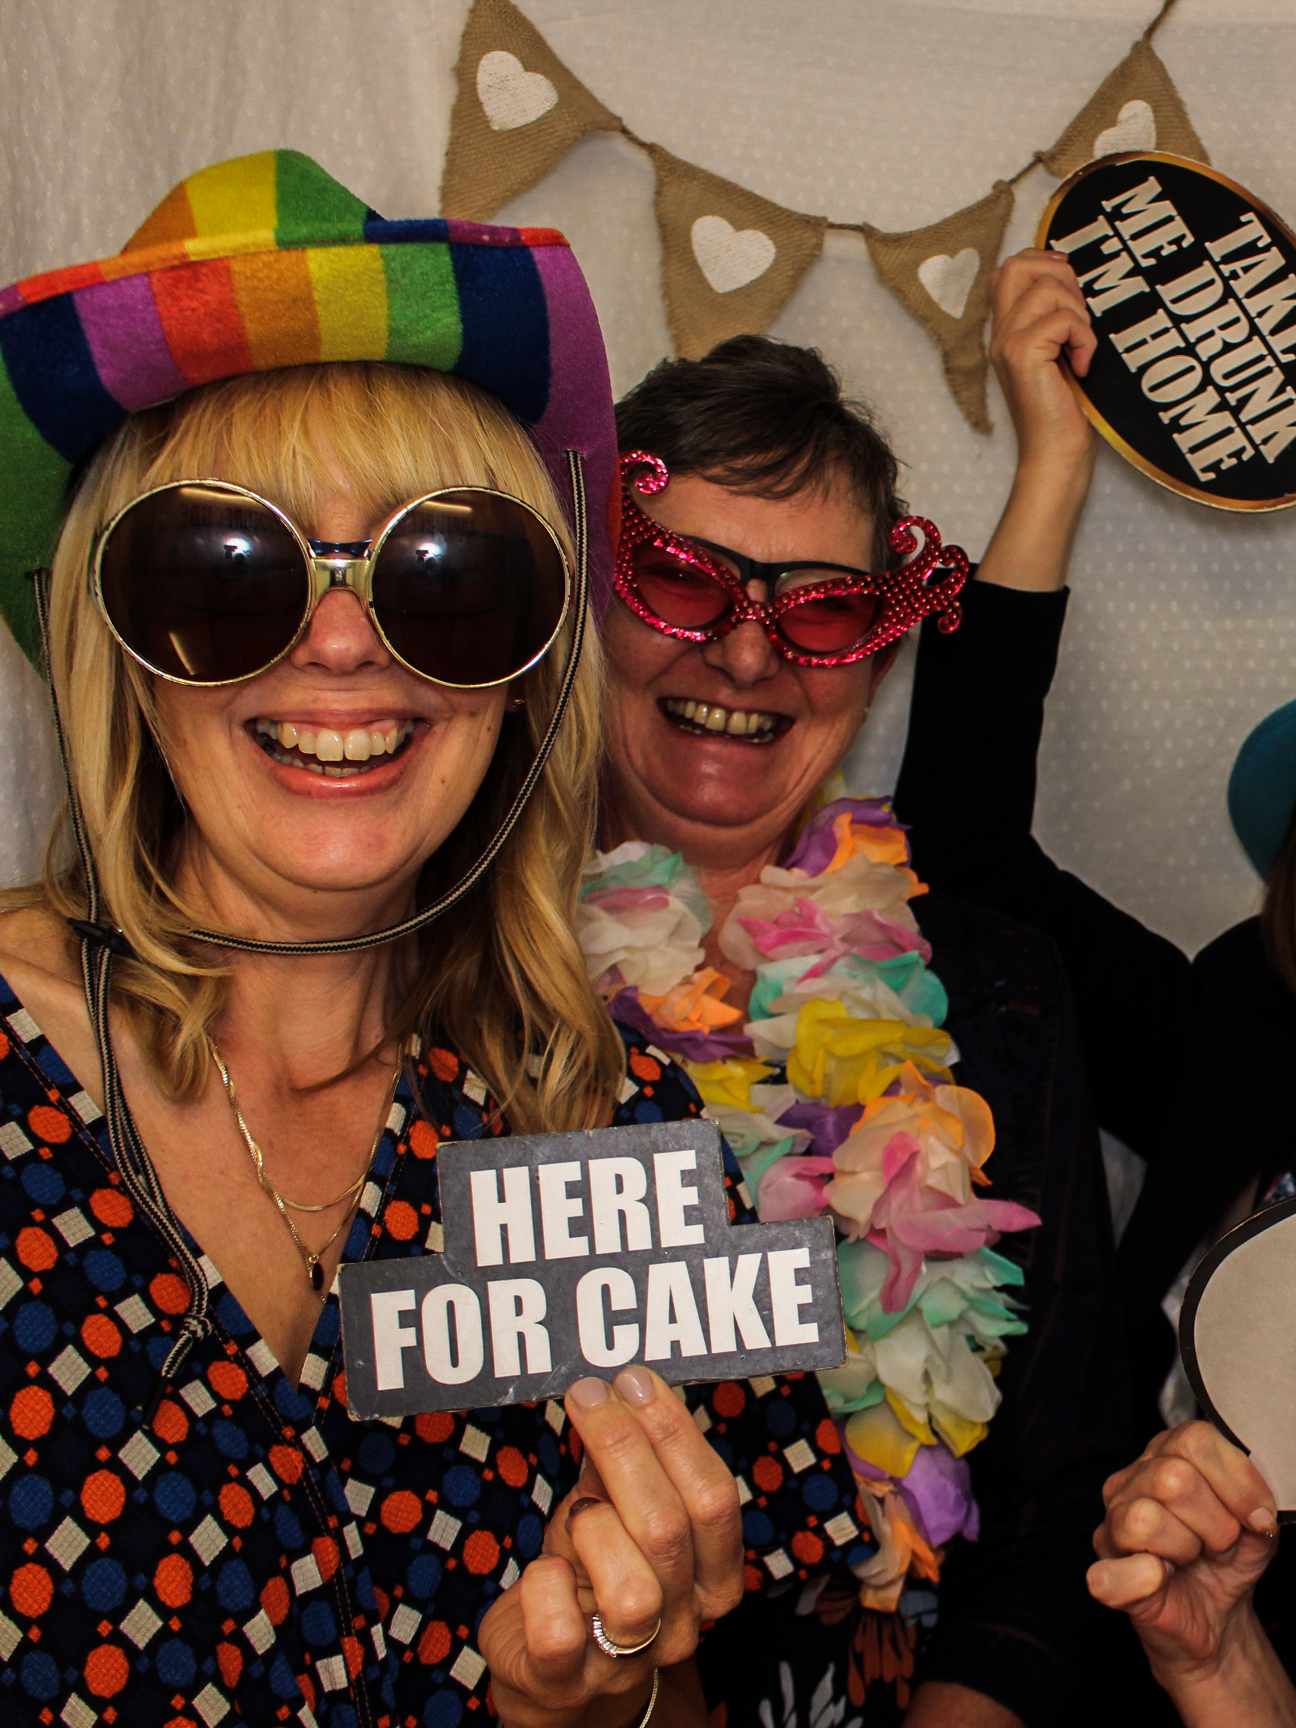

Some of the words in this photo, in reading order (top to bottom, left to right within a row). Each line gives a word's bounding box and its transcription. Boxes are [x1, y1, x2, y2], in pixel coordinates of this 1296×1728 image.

[1101, 176, 1195, 267] ME
[1050, 215, 1150, 317] I'M
[1109, 309, 1256, 482] HOME
[469, 1149, 705, 1267] HERE
[370, 1278, 552, 1391] FOR
[576, 1247, 820, 1367] CAKE
